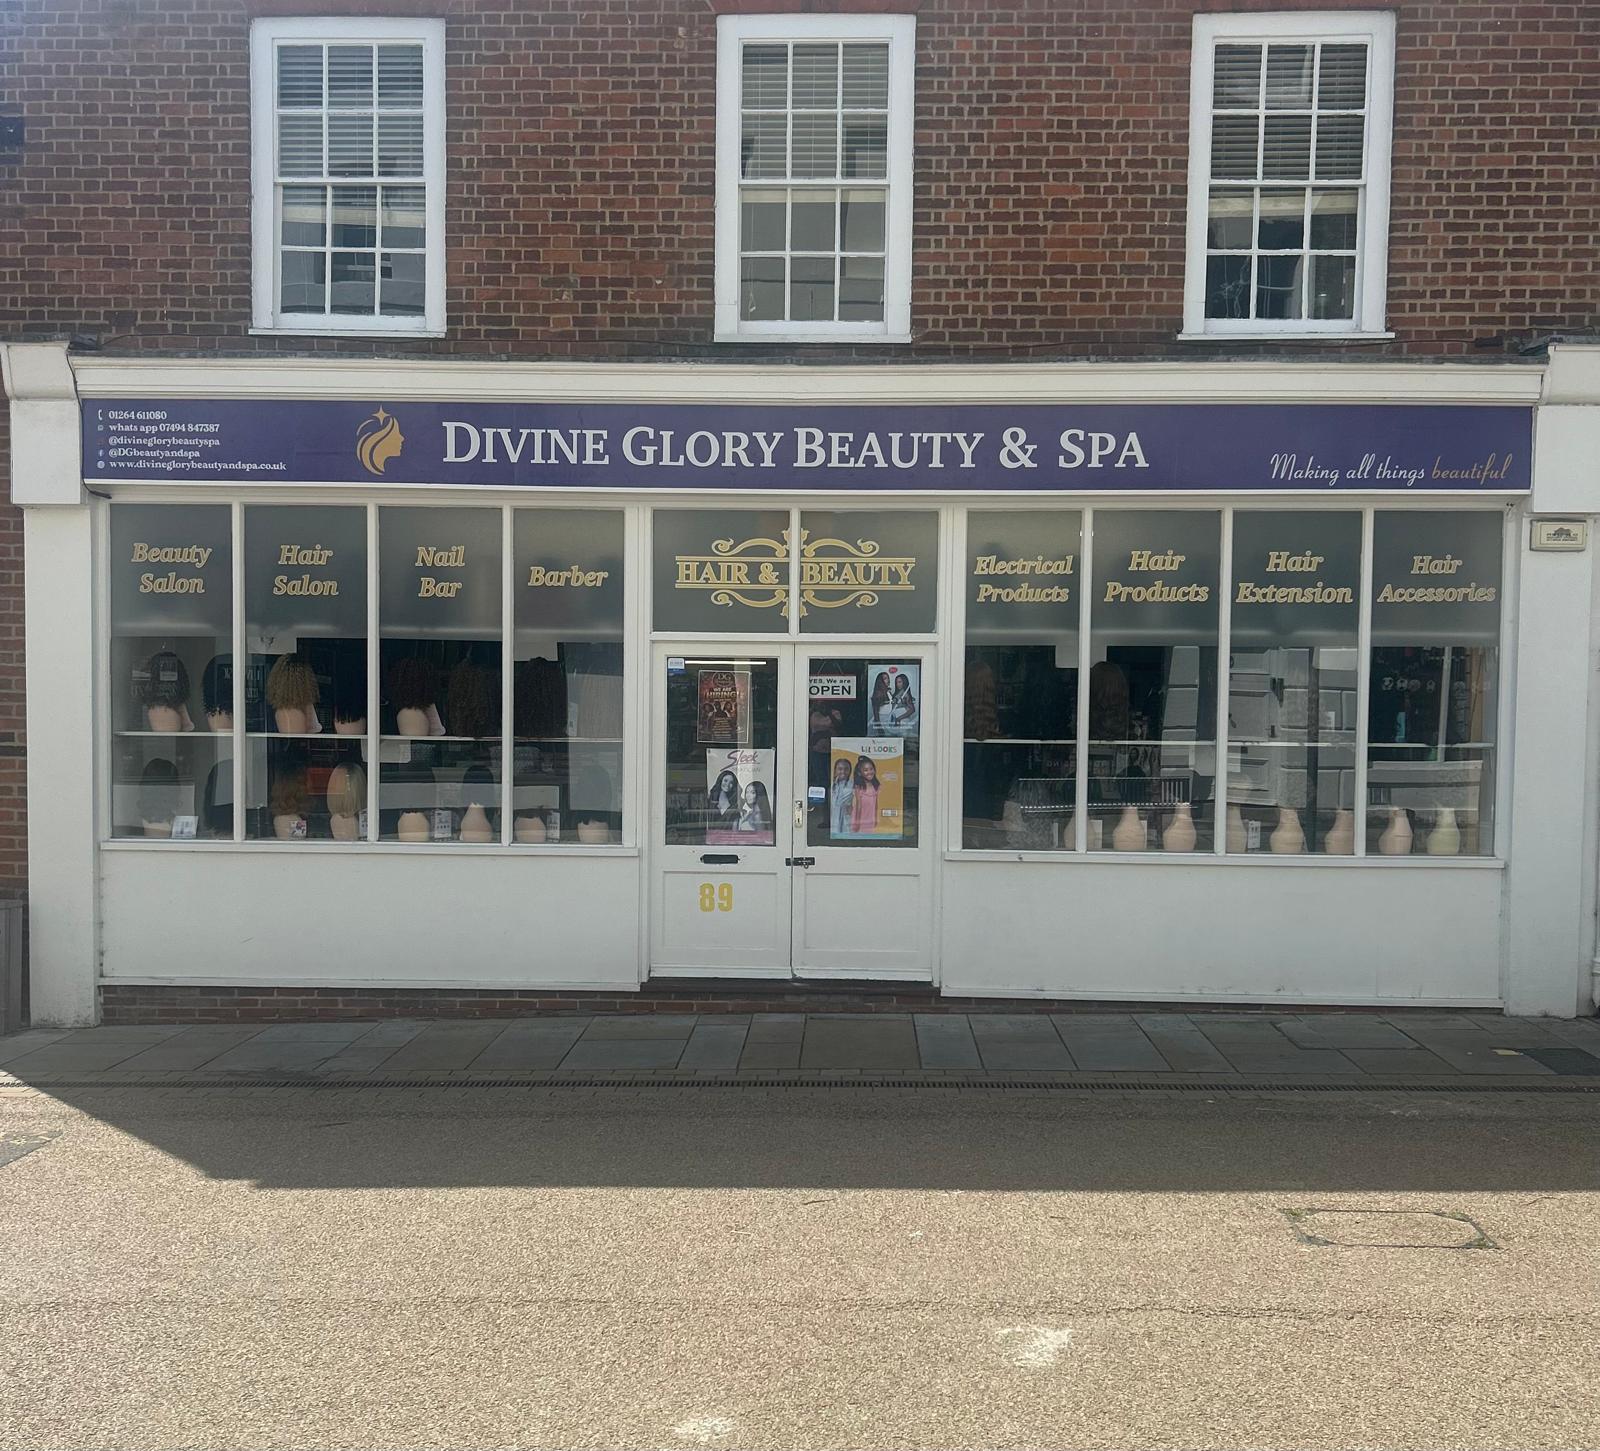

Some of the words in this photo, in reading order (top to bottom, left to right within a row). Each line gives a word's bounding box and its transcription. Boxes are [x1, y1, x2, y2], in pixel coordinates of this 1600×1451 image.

[108, 411, 135, 420] 01264
[136, 411, 167, 420] 611080
[109, 423, 138, 432] whats
[139, 425, 158, 434] app
[159, 423, 186, 432] 07494
[108, 436, 220, 447] @divineglorybeautyspa
[442, 421, 609, 465] DIVINE
[622, 426, 784, 467] GLORY
[793, 427, 985, 469] BEAUTY
[999, 426, 1038, 469] &
[1058, 429, 1150, 469] SPA
[108, 448, 201, 459] @DGbeautyandspa
[109, 460, 287, 471] www.divineglorybeautyandspa.co.uk
[1270, 453, 1340, 486] Making
[1346, 453, 1376, 479] all
[1376, 455, 1425, 486] things
[1431, 453, 1513, 485] beautiful
[131, 542, 212, 569] Beauty
[278, 544, 333, 566] Hair
[415, 545, 465, 567] Nail
[974, 555, 1074, 575] Electrical
[1128, 550, 1185, 572] Hair
[1265, 550, 1325, 573] Hair
[1410, 555, 1463, 575] Hair
[139, 571, 205, 594] Salon
[527, 565, 609, 587] Barber
[676, 561, 750, 584] HAIR
[758, 562, 779, 584] &
[801, 562, 915, 585] BEAUTY
[272, 574, 339, 596] Salon
[418, 577, 463, 598] Bar
[976, 583, 1070, 603] Products
[1104, 580, 1209, 603] Products
[1235, 581, 1353, 604] Extension
[1377, 582, 1497, 603] Accessories
[809, 685, 851, 696] OPEN
[720, 750, 759, 770] Sleek
[699, 883, 733, 912] 89
